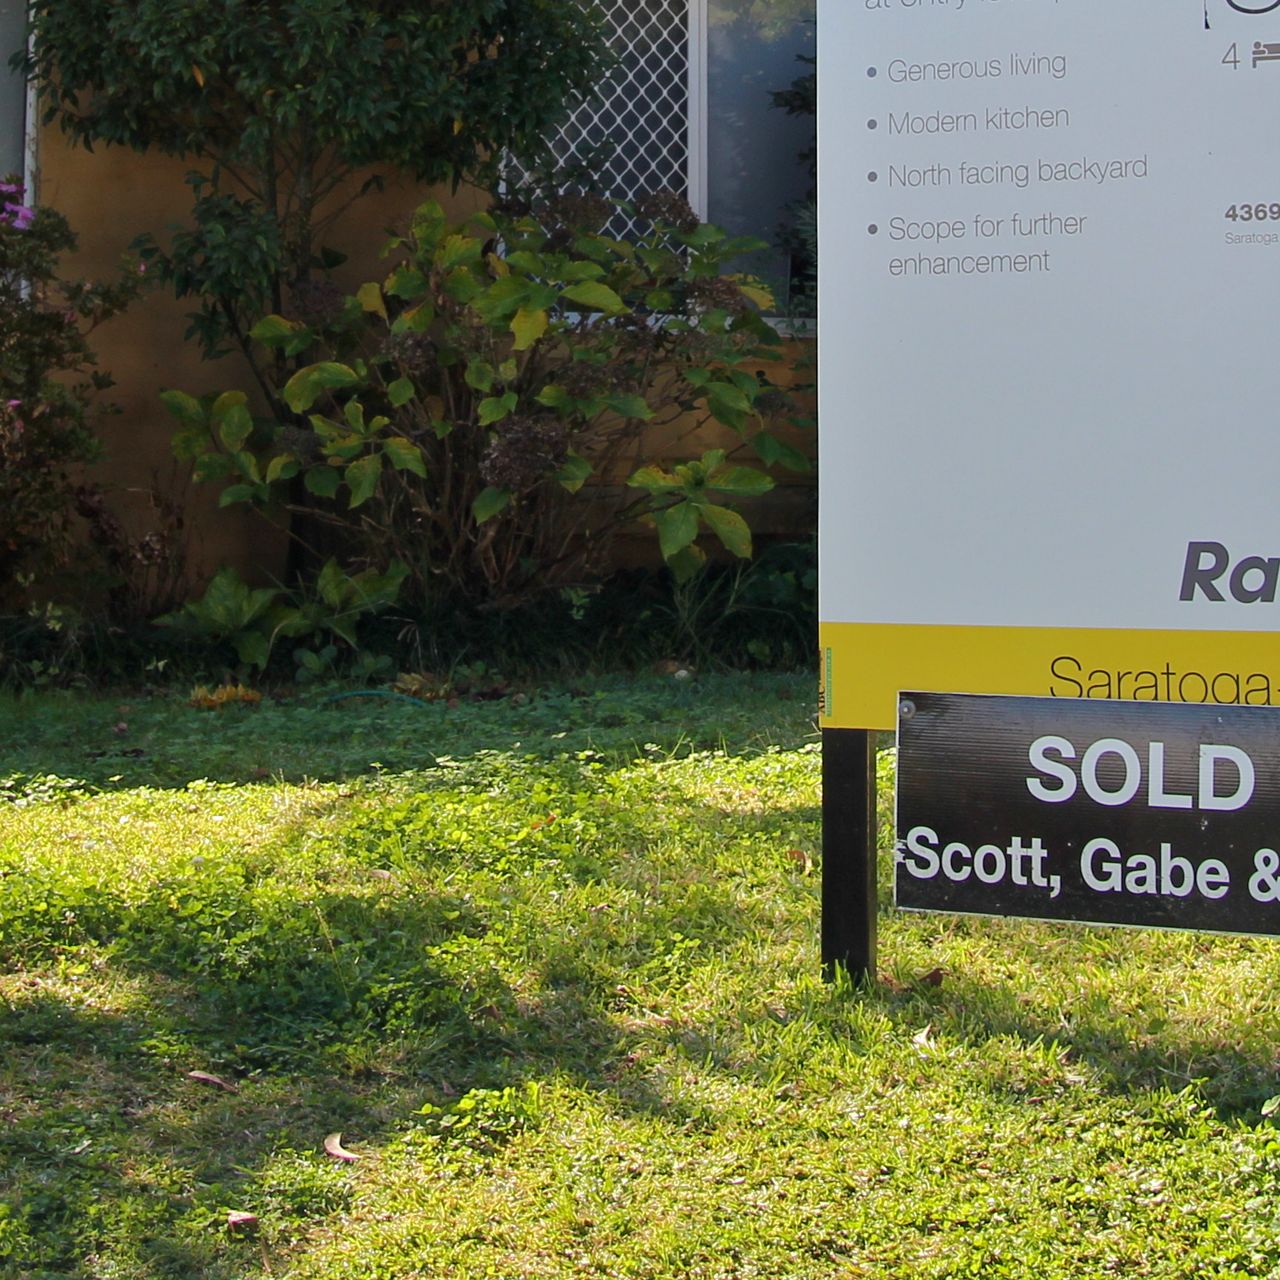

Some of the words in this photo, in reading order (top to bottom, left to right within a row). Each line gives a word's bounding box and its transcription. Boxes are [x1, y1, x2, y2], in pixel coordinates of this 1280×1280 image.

[887, 58, 1002, 83] Generous
[1010, 51, 1067, 80] living
[1221, 41, 1241, 70] 4
[888, 110, 977, 135] Modern
[985, 105, 1070, 131] kitchen
[888, 163, 951, 187] North
[959, 160, 1030, 188] facing
[1038, 154, 1148, 184] backyard
[888, 216, 966, 244] Scope
[973, 214, 1005, 238] for
[1011, 212, 1088, 236] further
[1224, 230, 1279, 245] Saratoga
[888, 249, 1051, 276] enhancement
[1025, 735, 1256, 812] SOLD
[904, 825, 1062, 899] Scott,
[1079, 837, 1231, 900] Gabe
